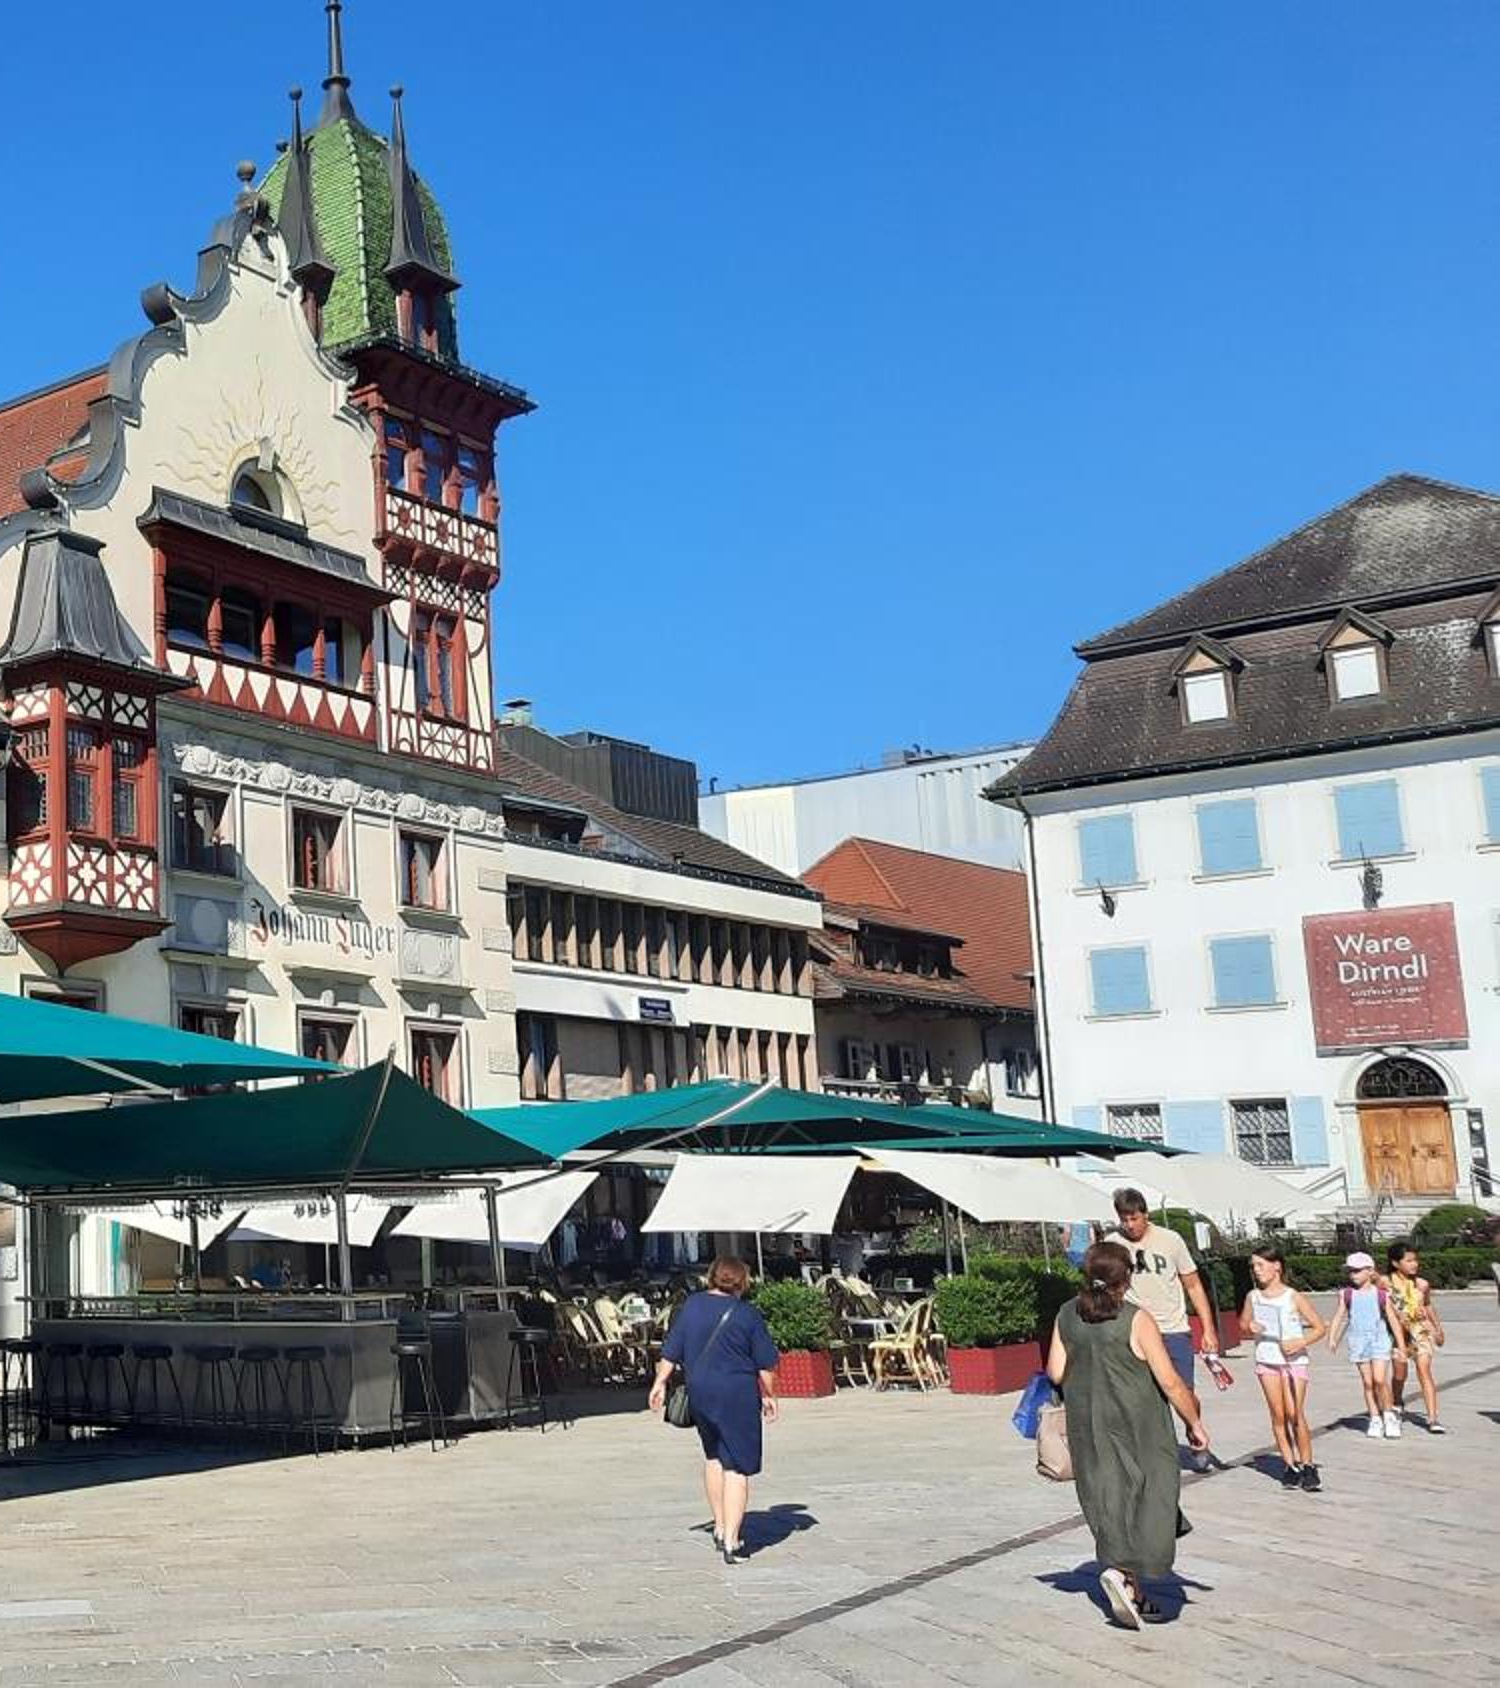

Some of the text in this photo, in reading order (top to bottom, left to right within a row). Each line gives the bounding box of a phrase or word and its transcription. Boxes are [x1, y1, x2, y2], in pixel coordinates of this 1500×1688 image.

[1333, 932, 1413, 957] Ware
[1337, 953, 1429, 984] Dirndl
[1130, 1249, 1167, 1275] AP
